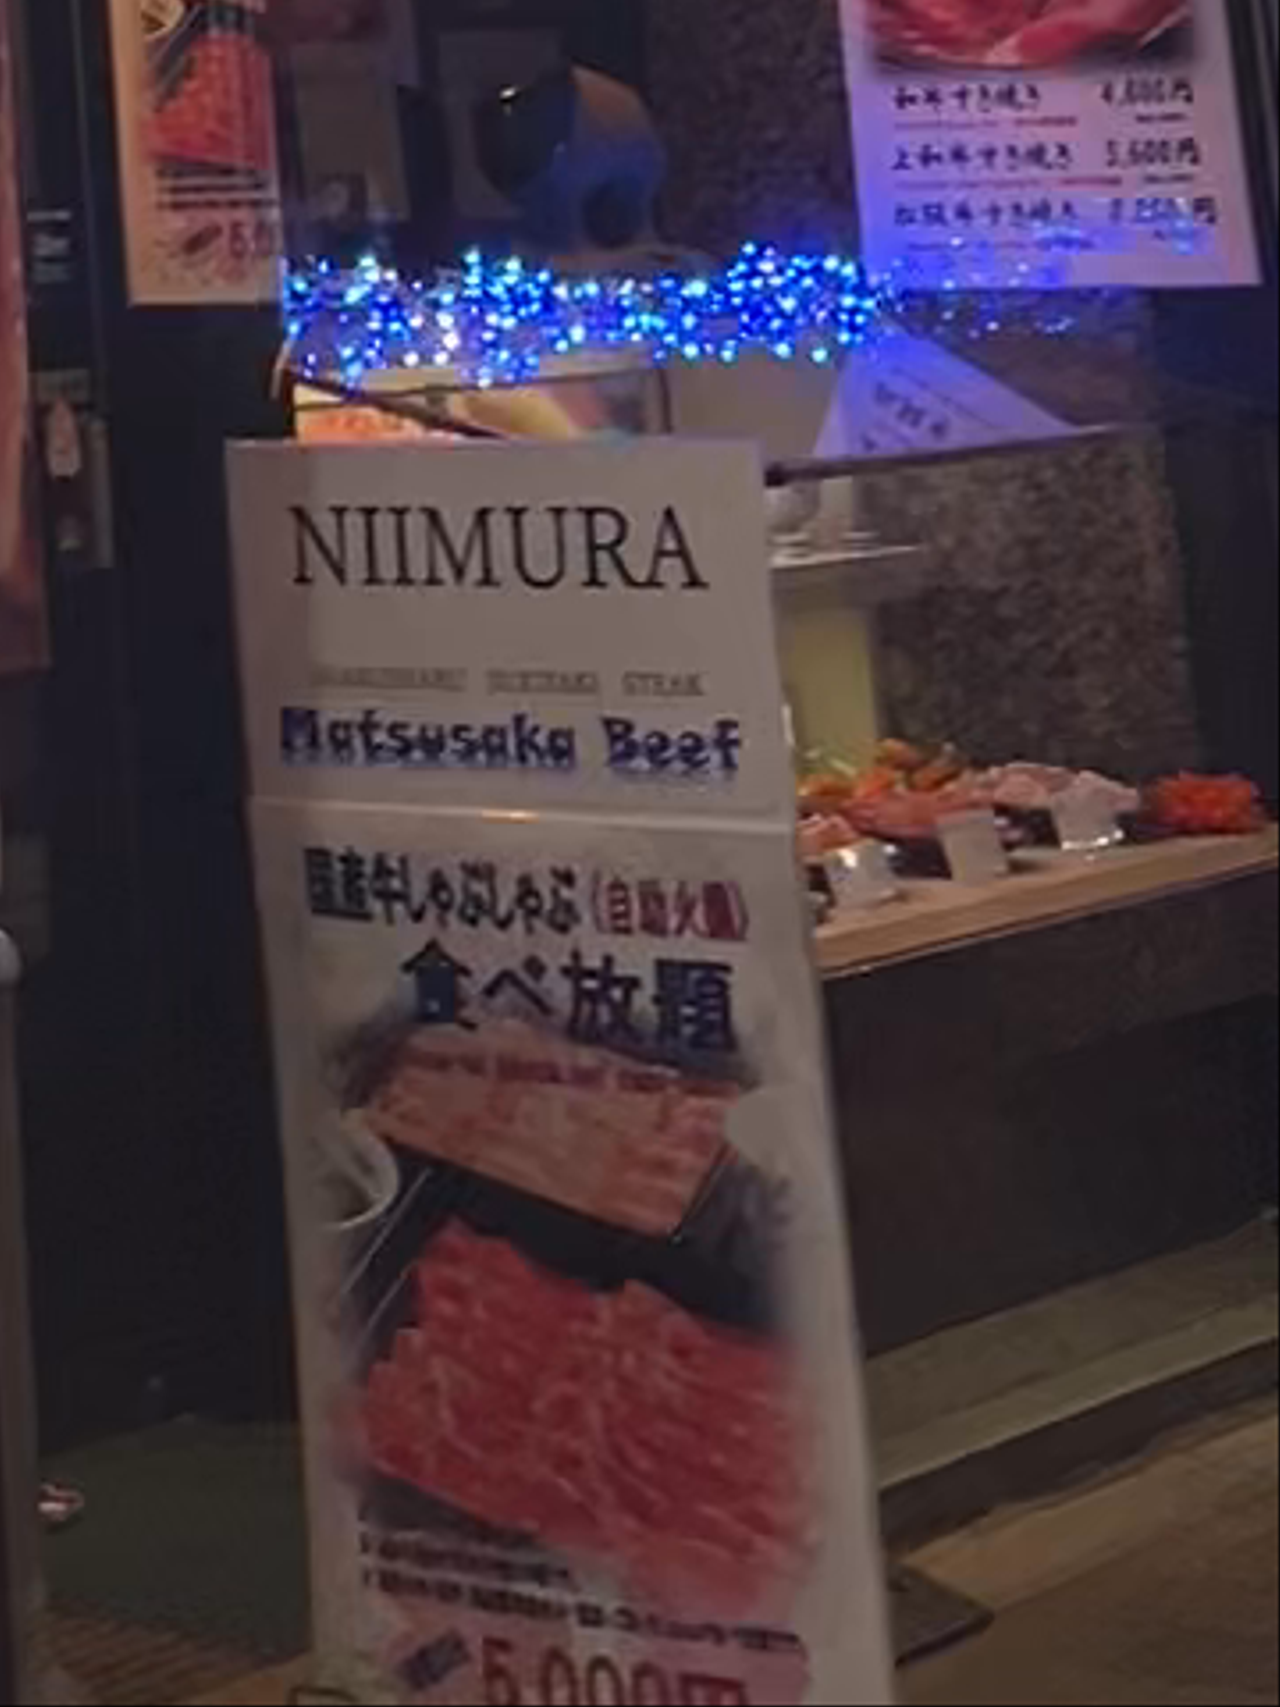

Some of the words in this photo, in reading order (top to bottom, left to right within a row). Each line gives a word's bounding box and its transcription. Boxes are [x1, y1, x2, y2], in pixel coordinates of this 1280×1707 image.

[286, 504, 710, 591] NIIMURA
[280, 705, 578, 768] Matsusaka
[600, 716, 743, 771] Beef
[401, 938, 738, 1053] 食べ放題
